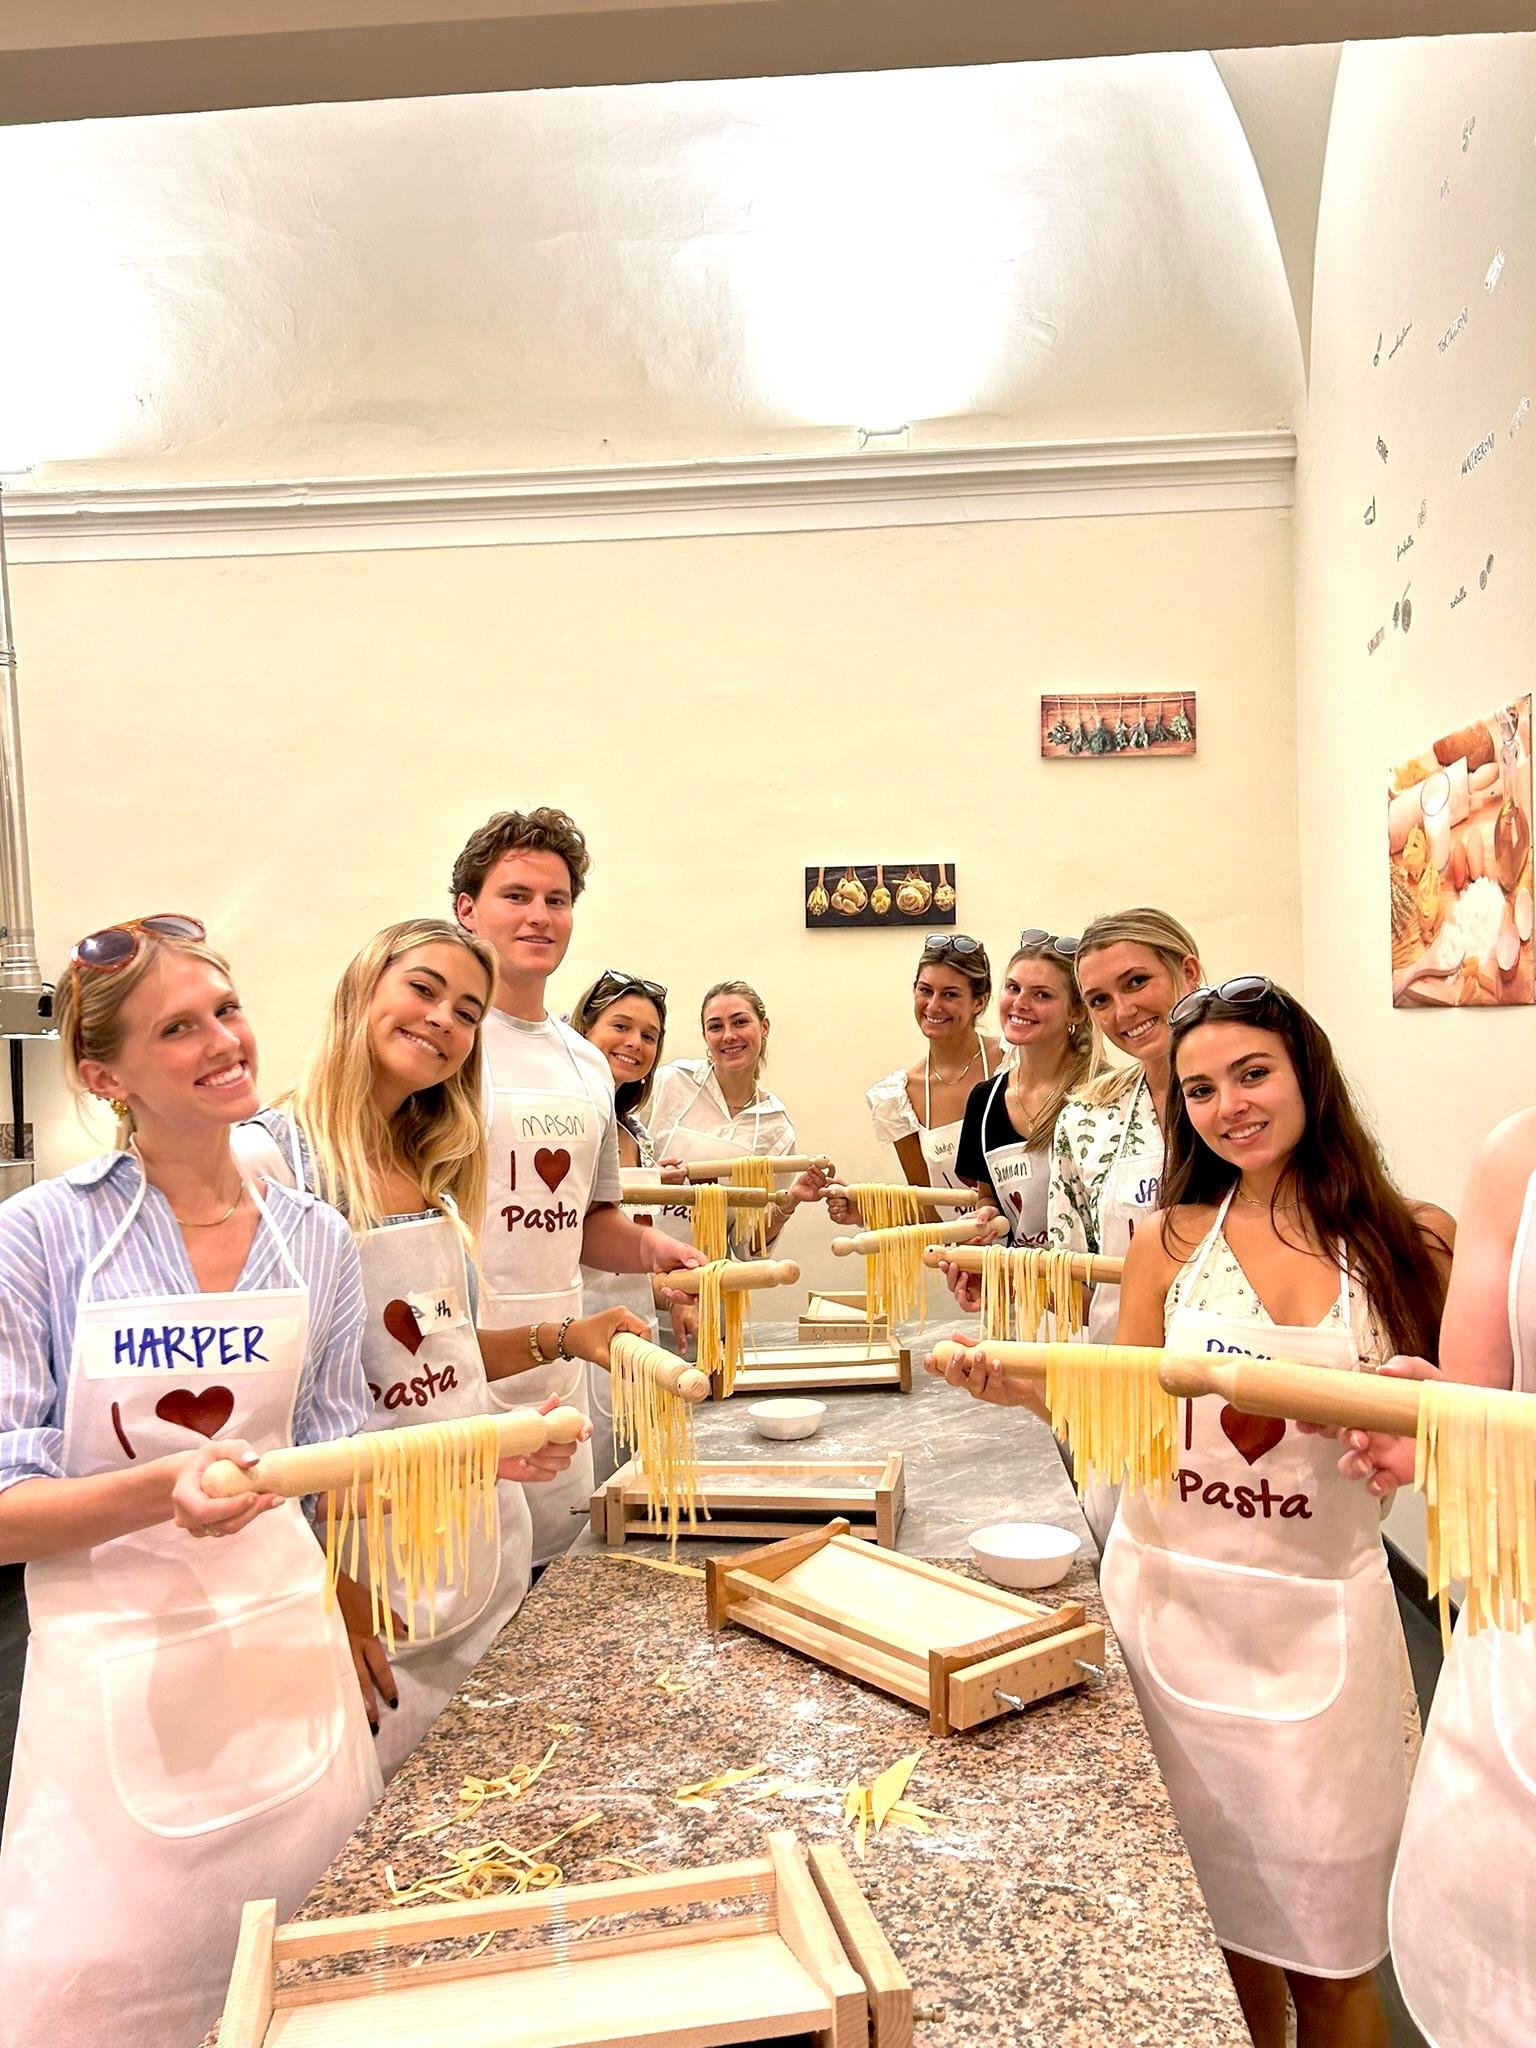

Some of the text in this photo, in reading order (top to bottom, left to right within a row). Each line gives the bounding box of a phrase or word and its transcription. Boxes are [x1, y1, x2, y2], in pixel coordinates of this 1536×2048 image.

[522, 1113, 585, 1137] MASON
[510, 1150, 517, 1192] I
[501, 1201, 578, 1232] Pasta
[114, 1325, 270, 1369] HARPER
[111, 1401, 137, 1460] I
[1185, 1397, 1193, 1451] I
[1172, 1468, 1313, 1520] Pasta
